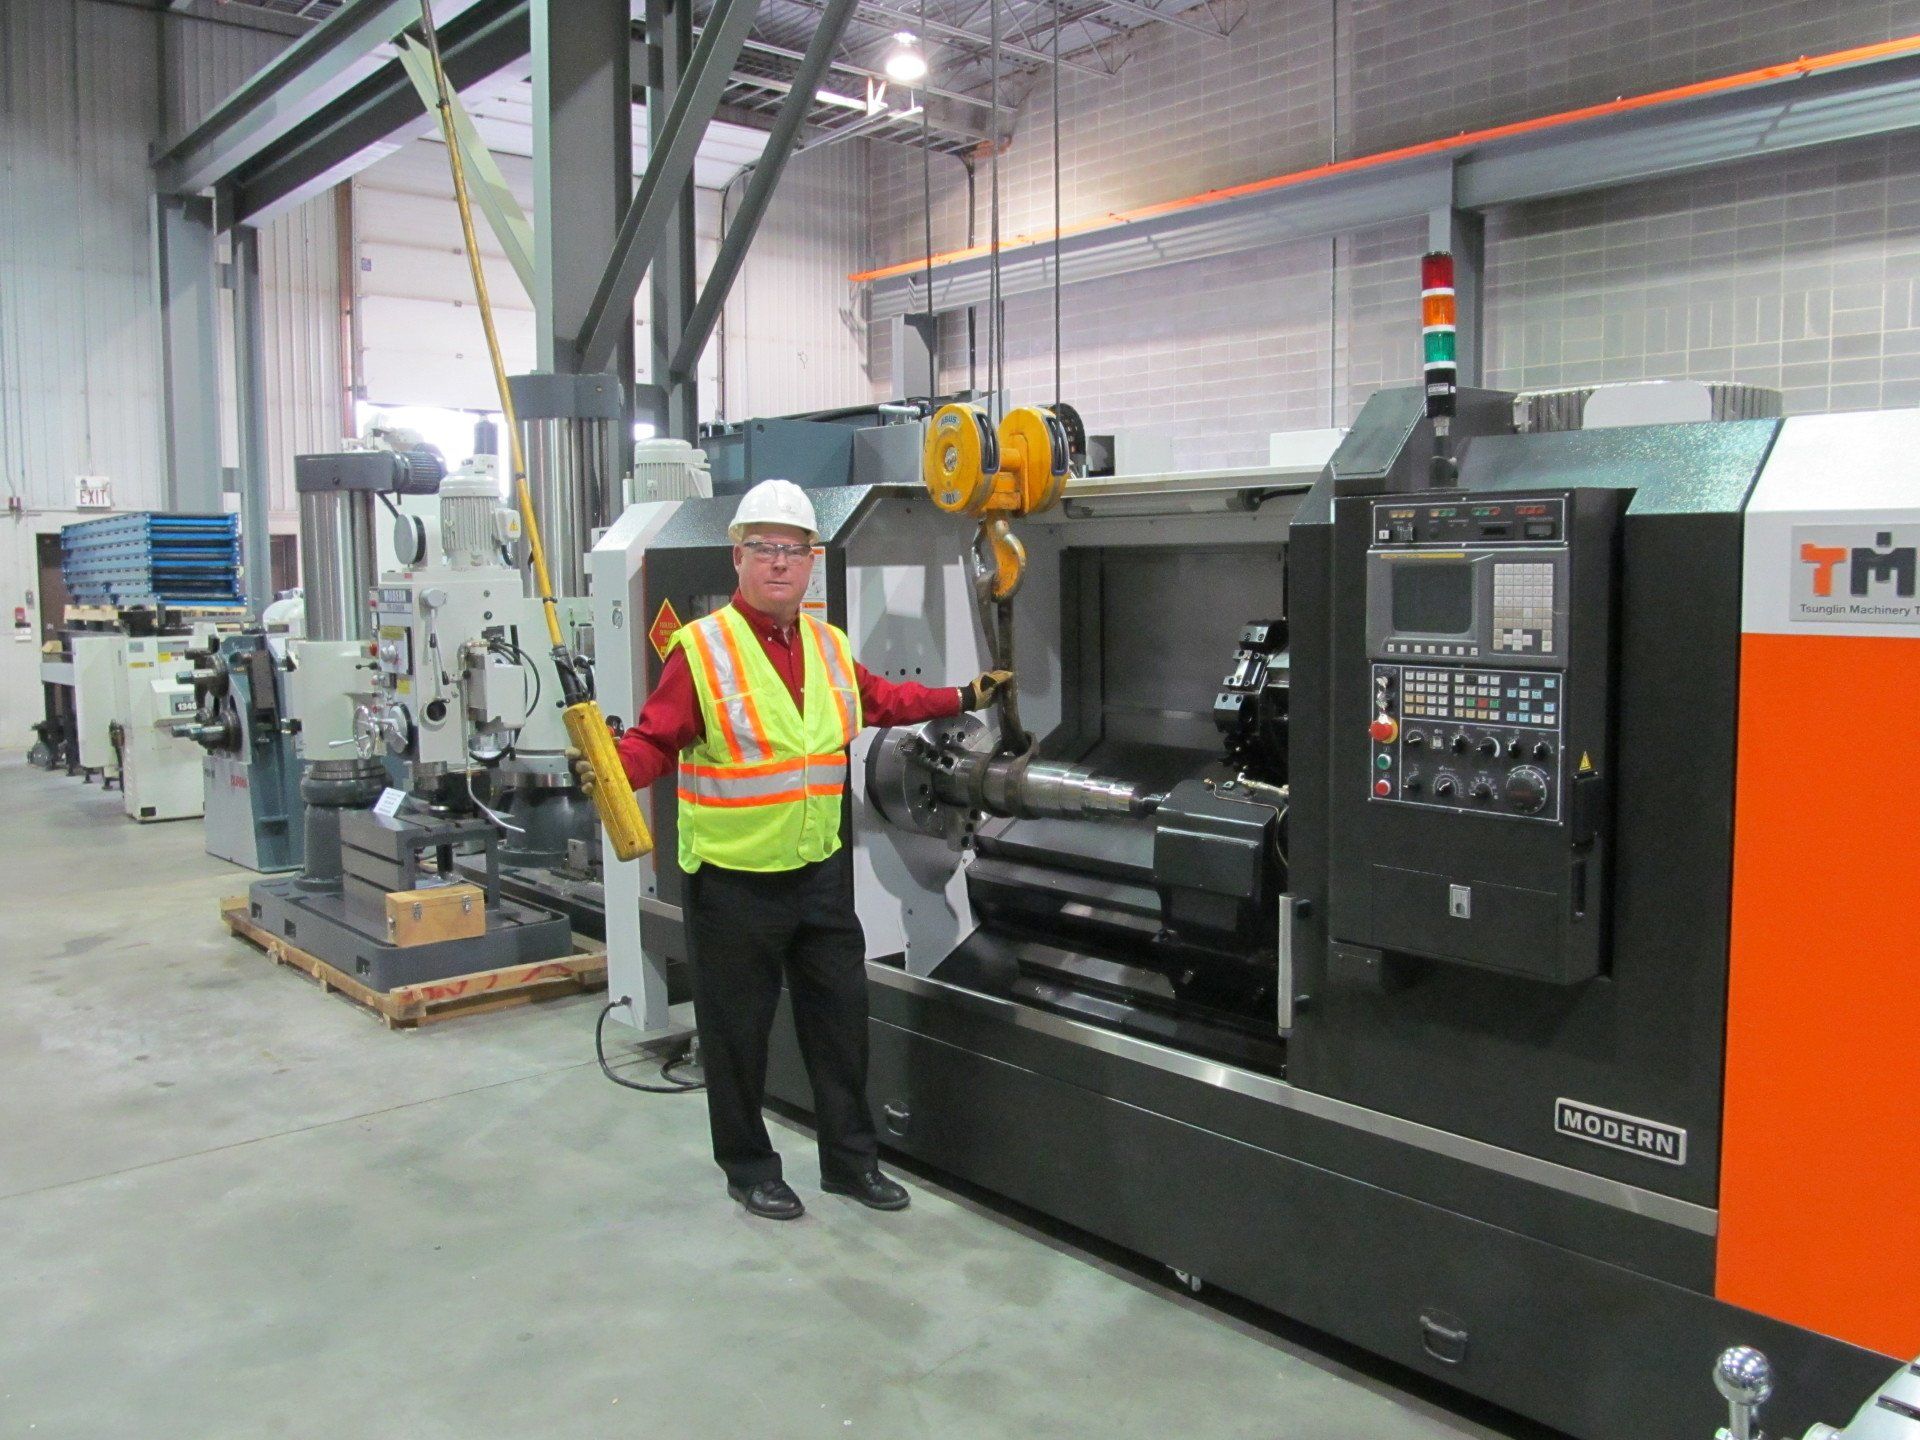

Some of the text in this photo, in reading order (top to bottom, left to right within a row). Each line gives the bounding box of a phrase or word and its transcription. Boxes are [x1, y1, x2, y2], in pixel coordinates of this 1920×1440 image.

[79, 489, 106, 505] EXIT
[1800, 531, 1920, 598] TM
[1800, 603, 1846, 615] Tsunglin
[1849, 604, 1911, 617] Machinery
[1563, 1108, 1674, 1155] MODERN
